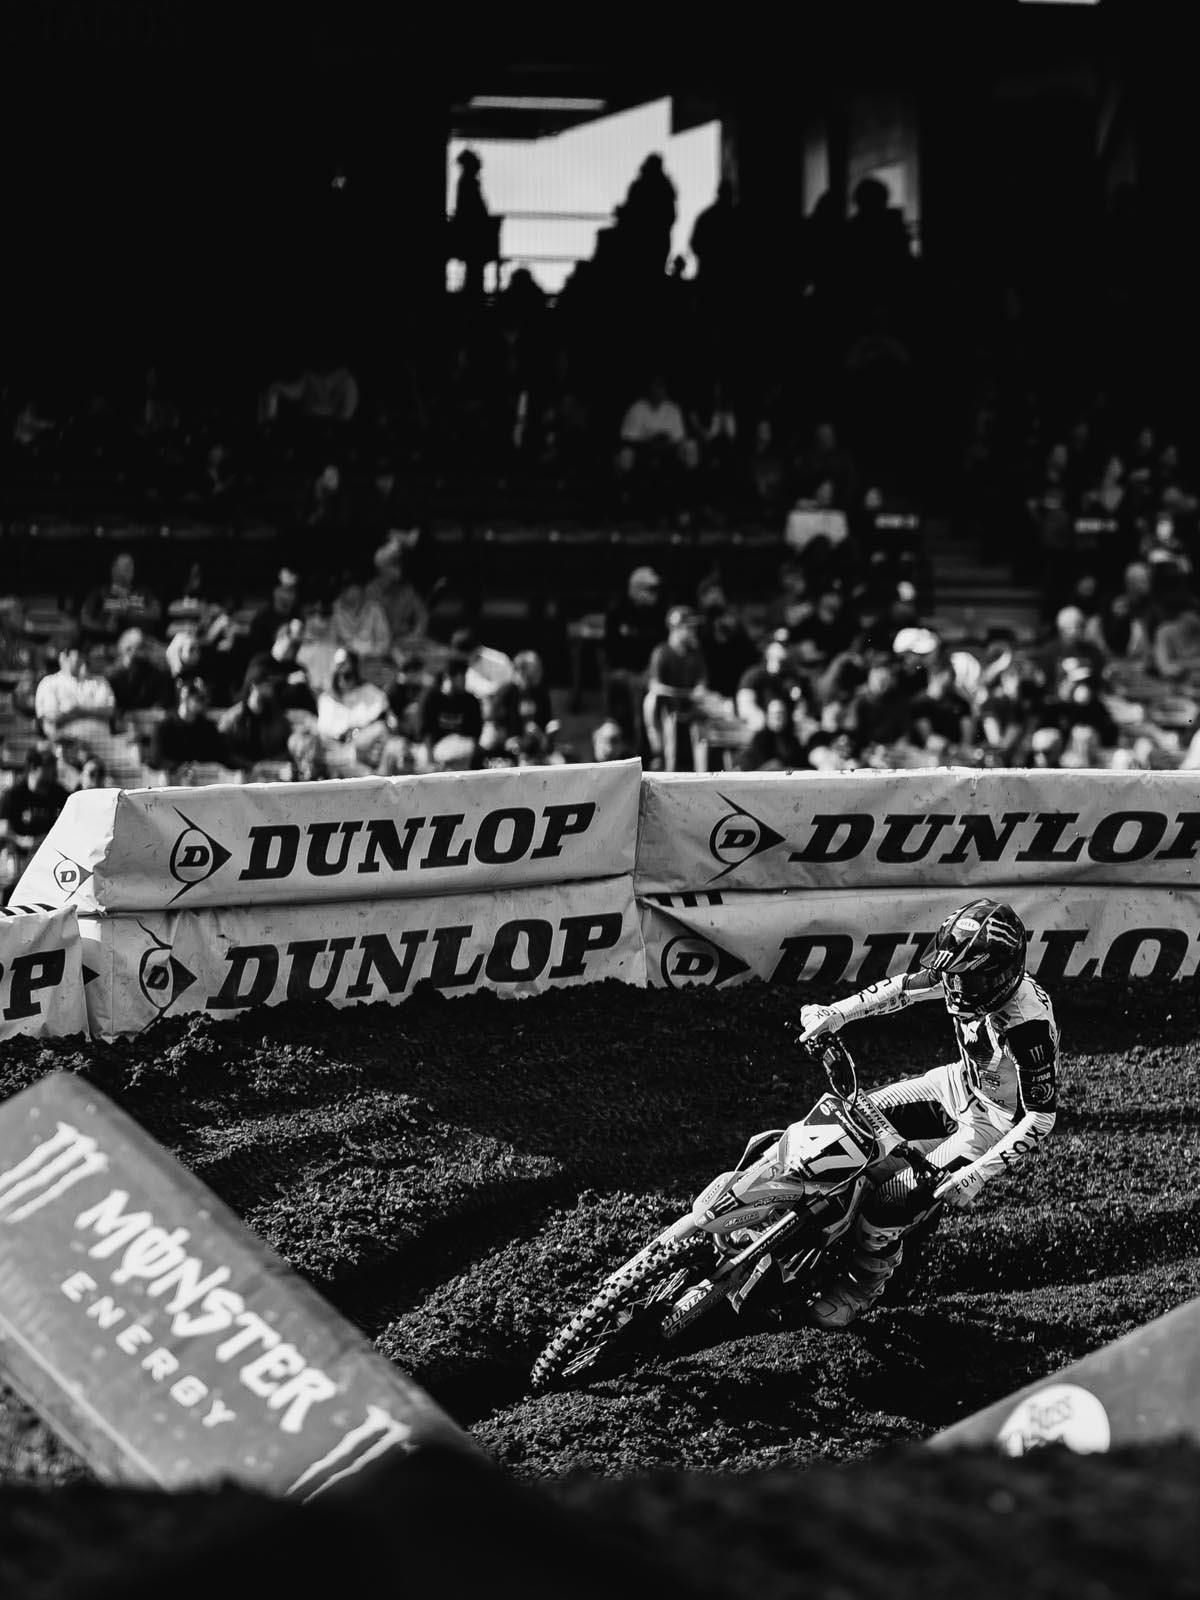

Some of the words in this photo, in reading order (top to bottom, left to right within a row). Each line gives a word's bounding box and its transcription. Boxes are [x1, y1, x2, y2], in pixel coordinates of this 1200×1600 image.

[240, 803, 596, 880] DUNLOP
[0, 948, 66, 1021] P
[205, 912, 623, 1010] DUNLOP
[1000, 1125, 1046, 1165] FOX
[955, 1173, 977, 1195] FOX
[60, 1271, 237, 1428] ENERGY
